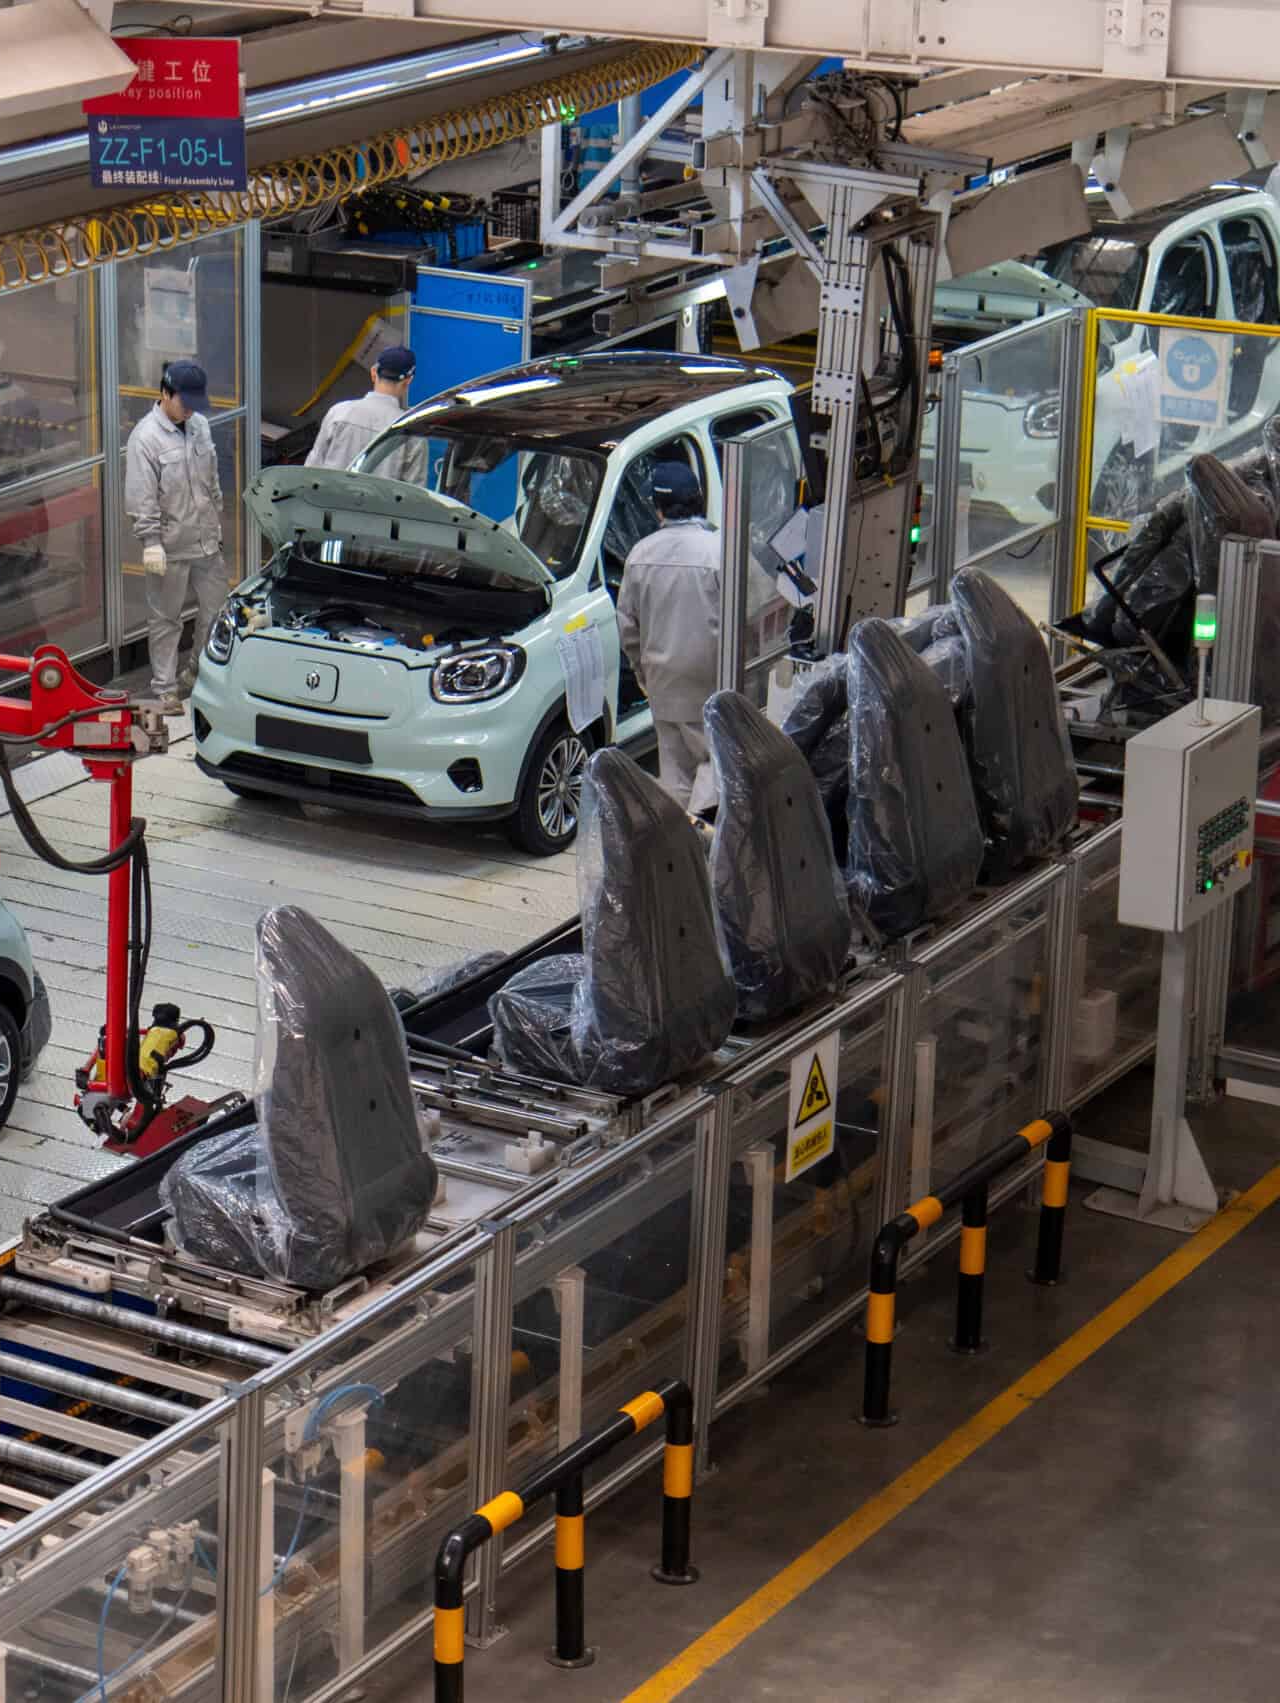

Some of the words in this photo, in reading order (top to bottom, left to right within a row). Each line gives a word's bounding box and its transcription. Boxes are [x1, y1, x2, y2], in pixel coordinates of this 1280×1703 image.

[138, 58, 212, 83] 键工位
[120, 88, 143, 100] ey
[149, 87, 201, 99] position
[99, 137, 233, 166] ZZ-F1-05-L
[164, 176, 182, 185] Final
[183, 176, 218, 187] Assembly
[218, 177, 236, 186] Line
